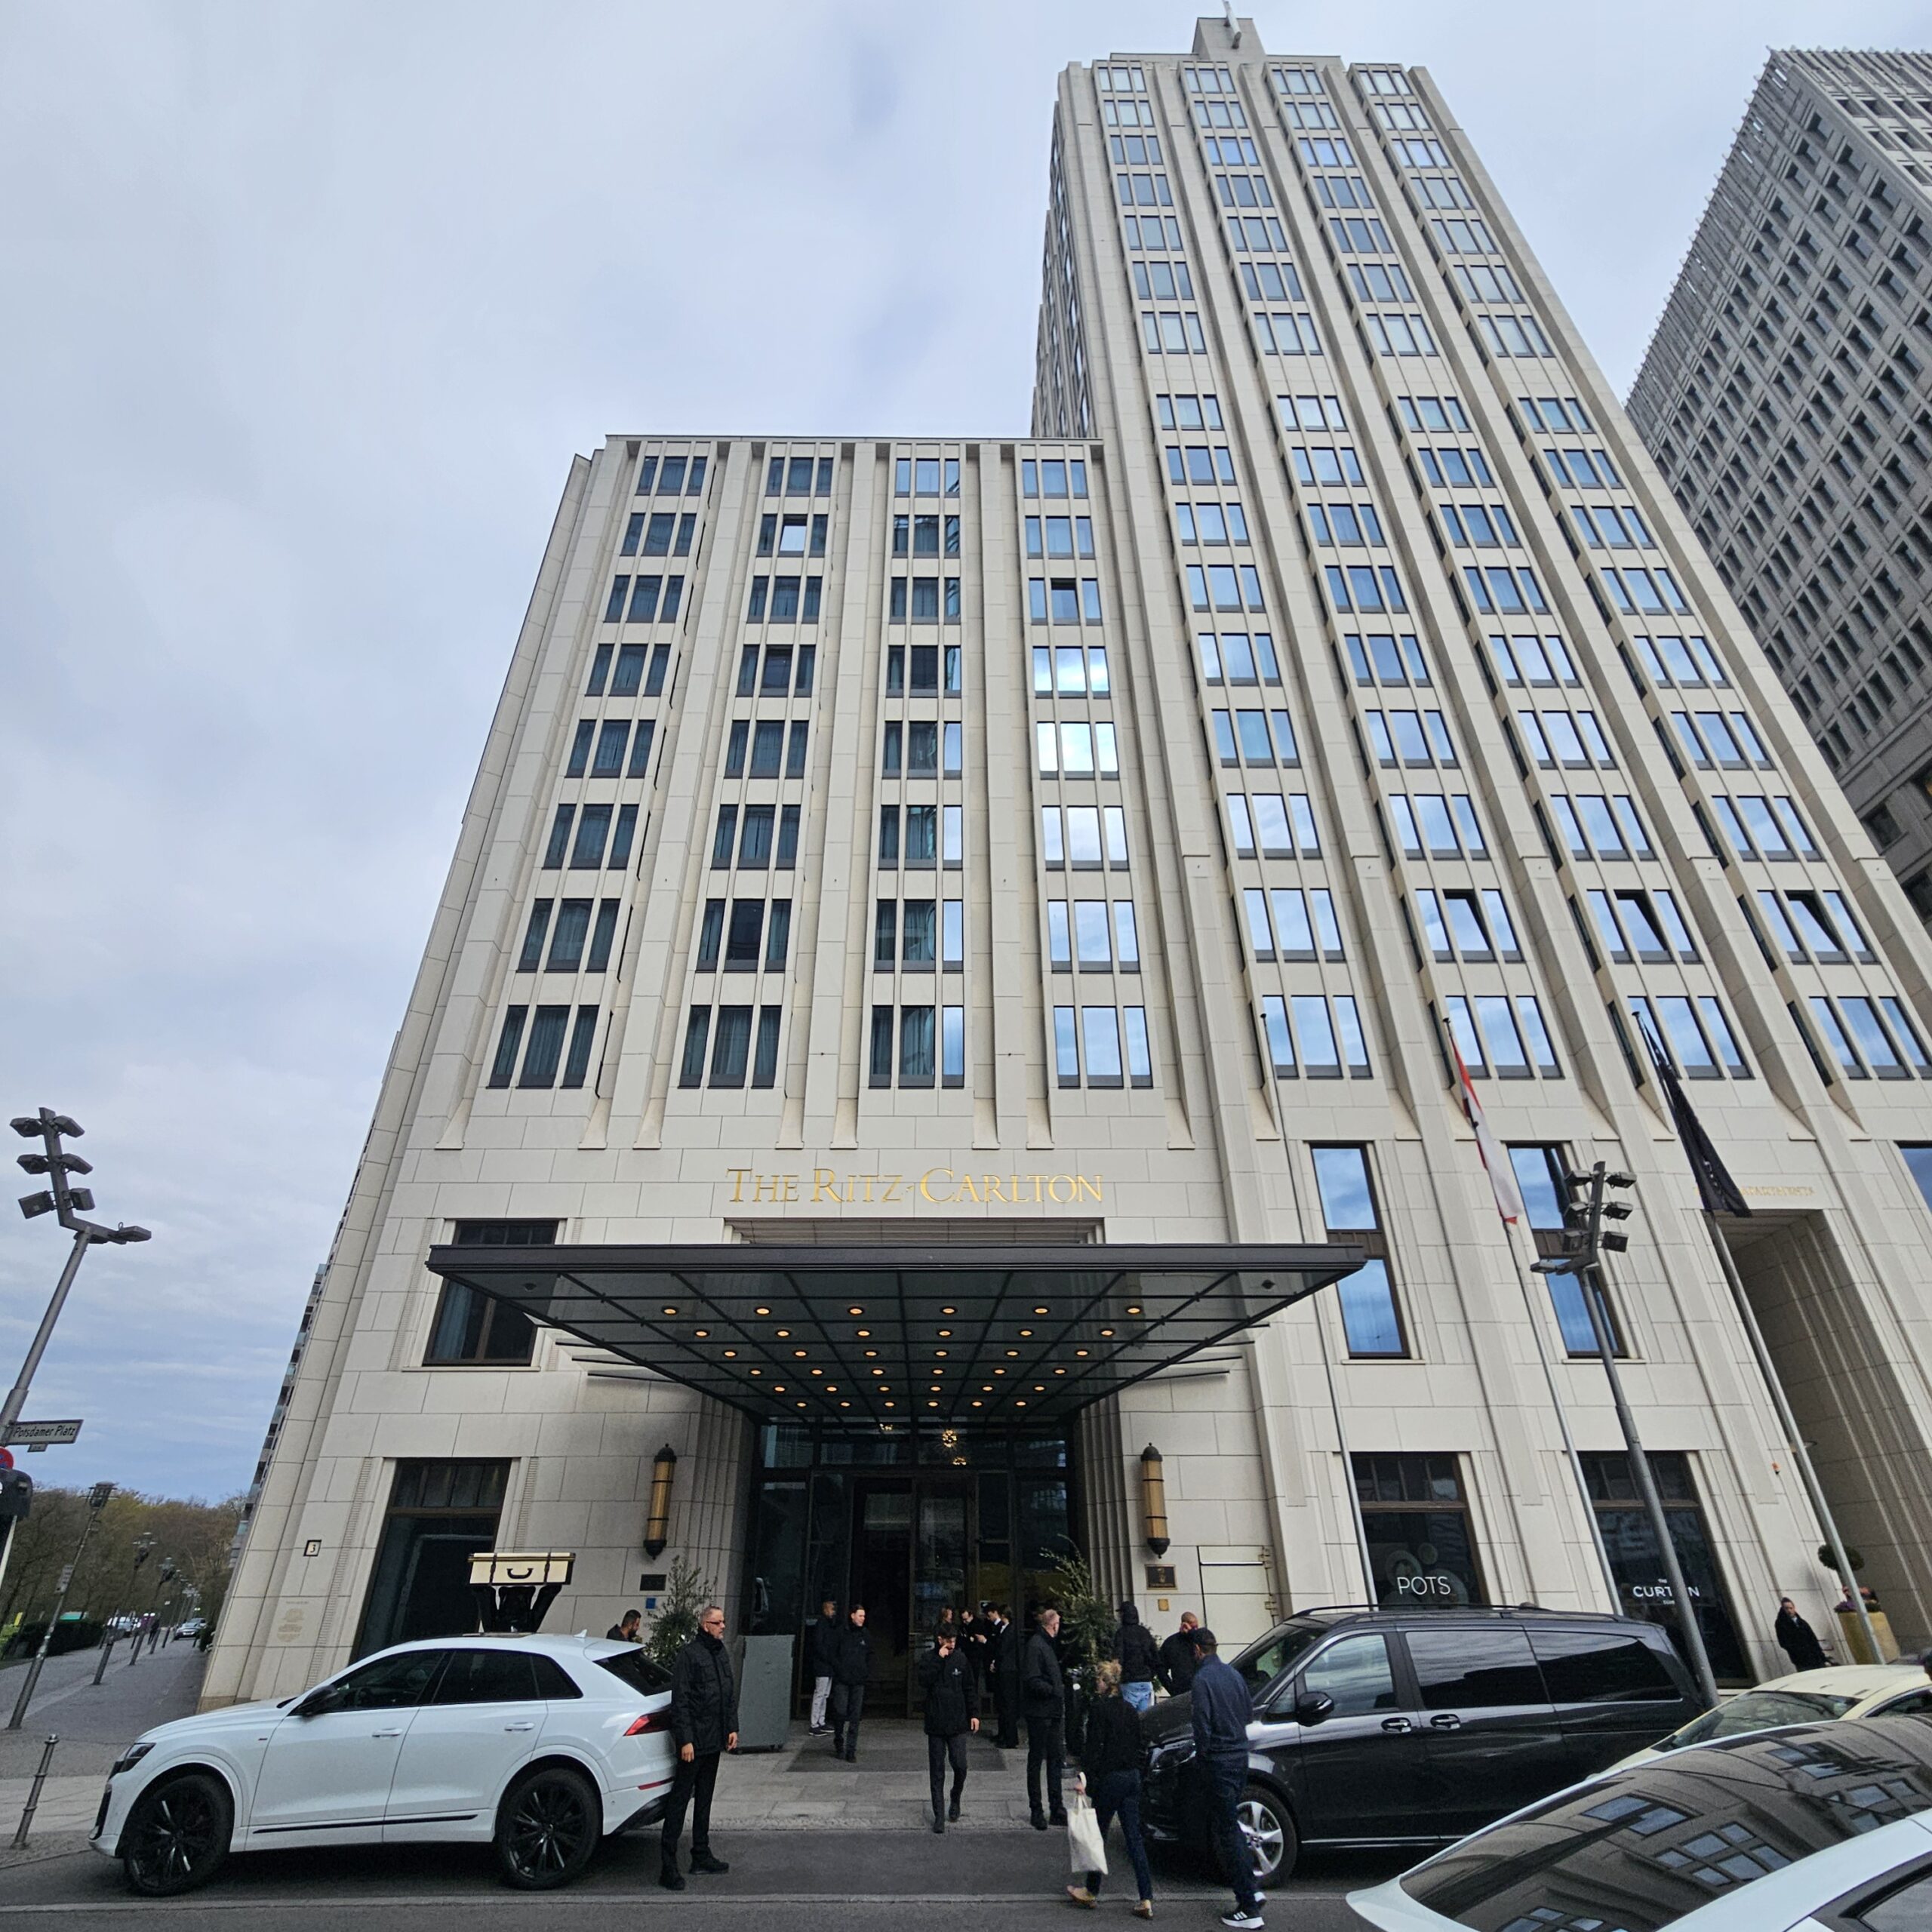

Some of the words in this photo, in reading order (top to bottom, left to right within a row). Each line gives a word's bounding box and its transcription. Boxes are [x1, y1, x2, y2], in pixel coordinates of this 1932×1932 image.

[725, 1168, 800, 1203] THE
[13, 1426, 54, 1438] Potsdamer
[54, 1424, 75, 1437] Platz
[1397, 1576, 1451, 1595] POTS
[1632, 1586, 1700, 1598] CURTN
